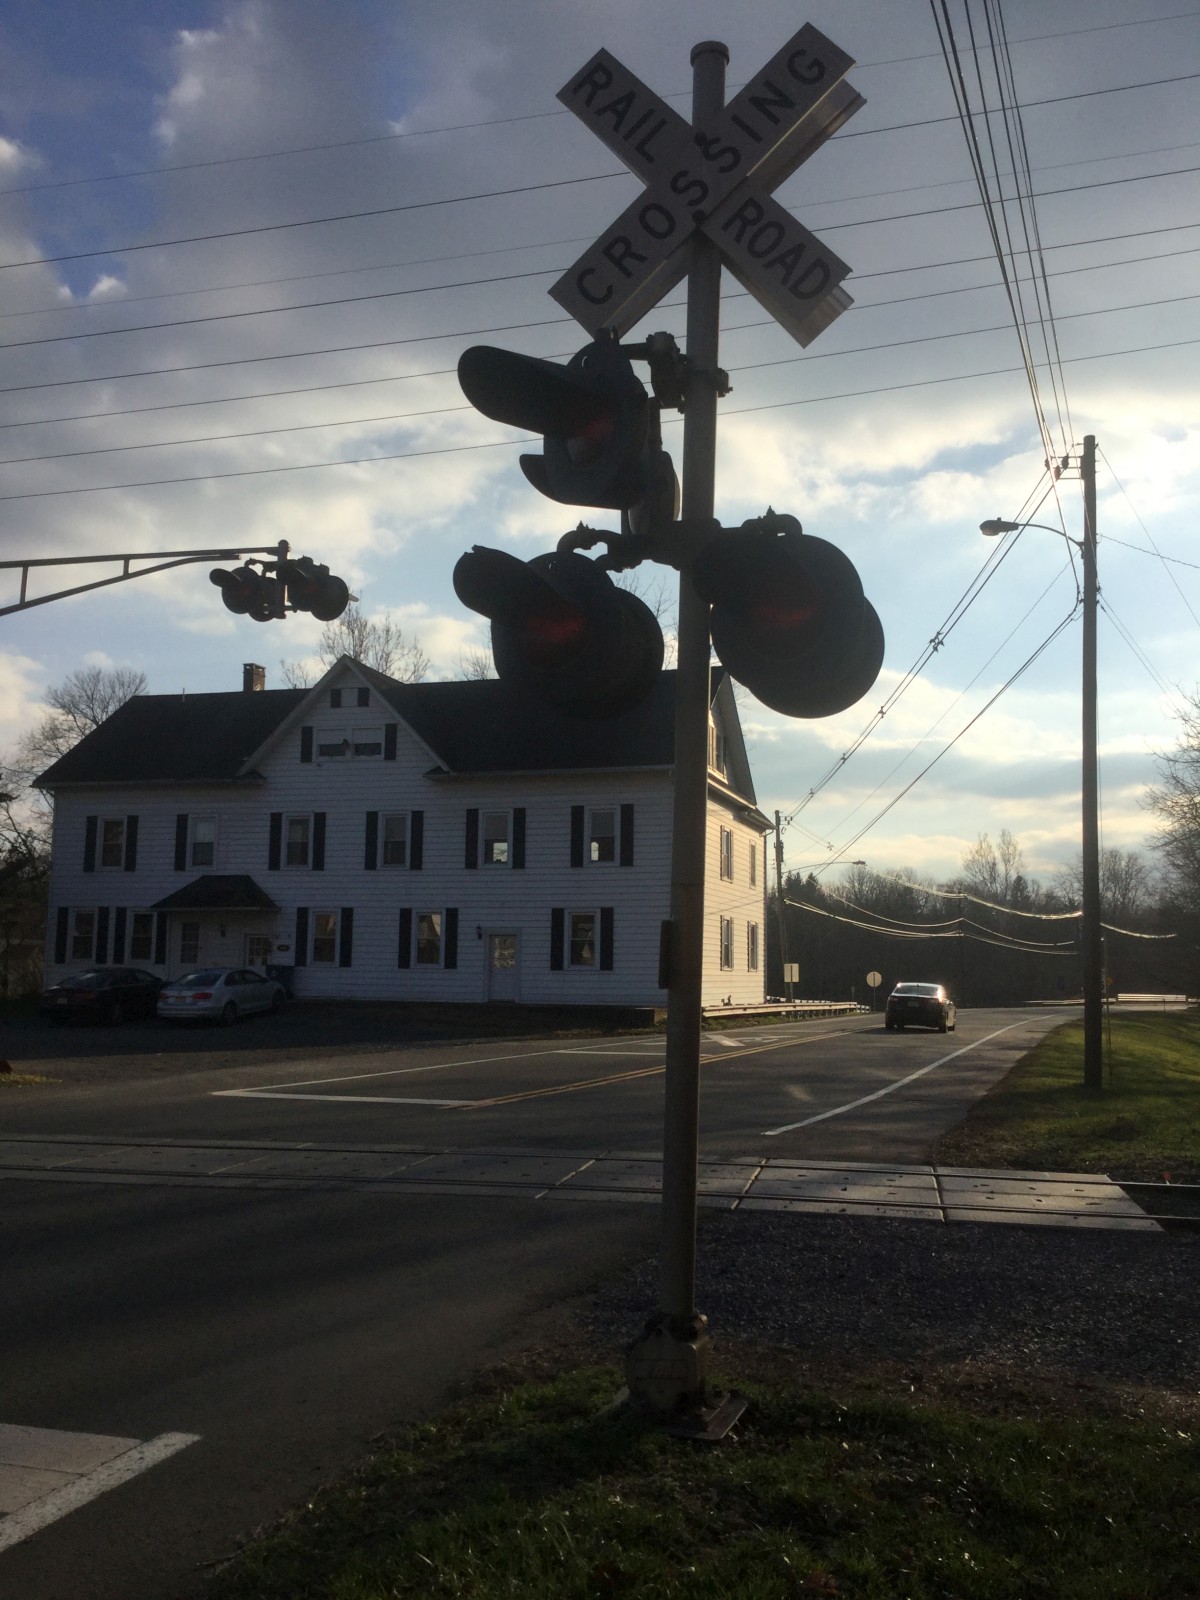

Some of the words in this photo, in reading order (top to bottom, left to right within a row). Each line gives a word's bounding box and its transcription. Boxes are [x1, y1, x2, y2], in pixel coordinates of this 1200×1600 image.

[572, 61, 667, 163] RAIL
[721, 196, 830, 300] ROAD
[576, 48, 826, 306] CROSSING
